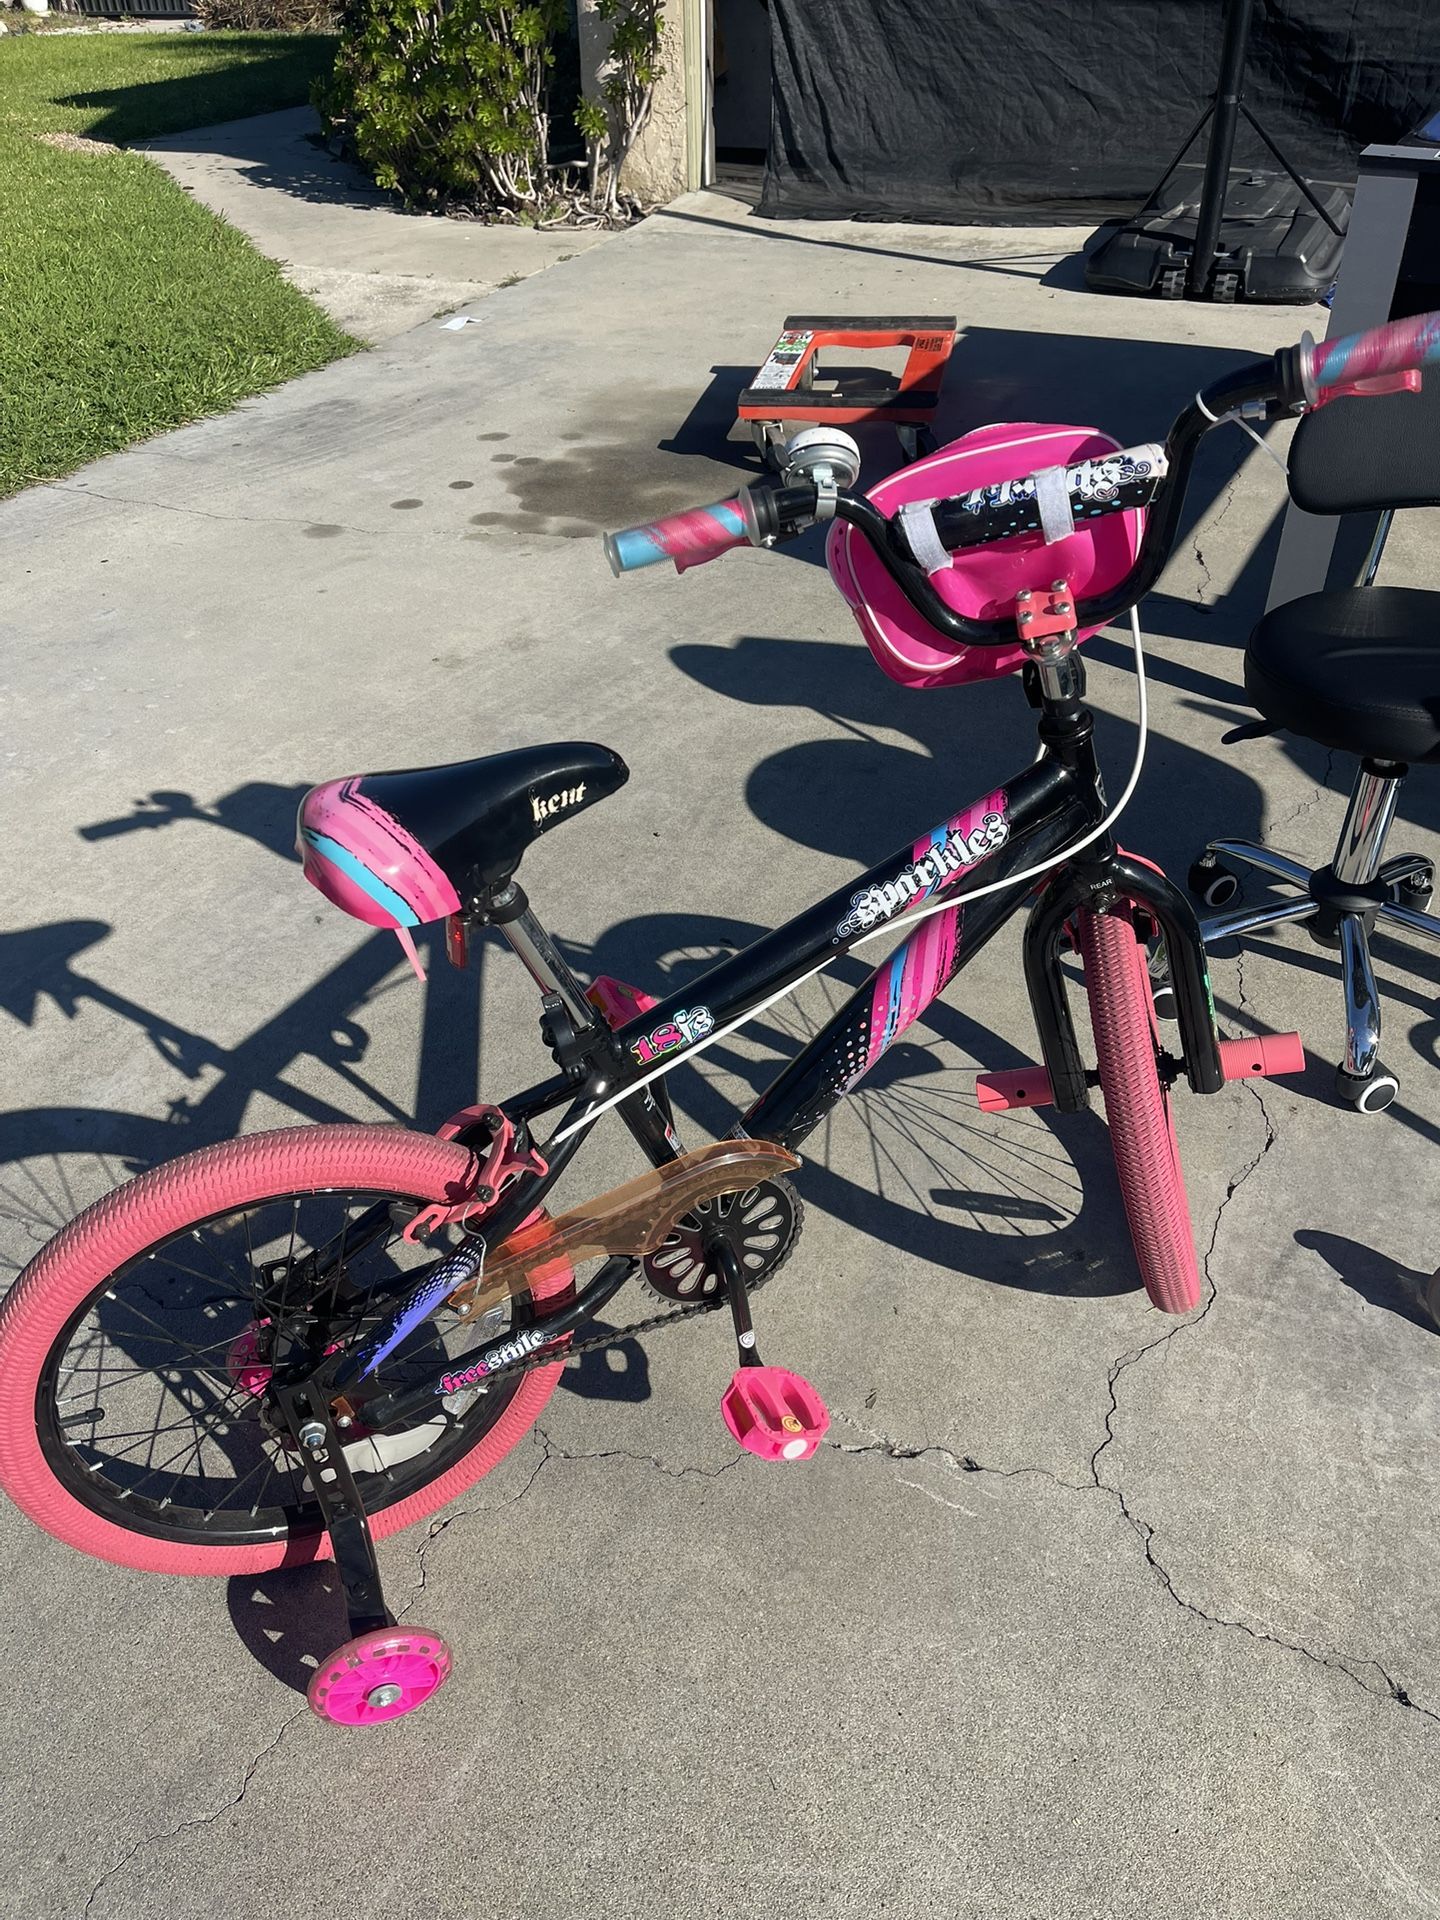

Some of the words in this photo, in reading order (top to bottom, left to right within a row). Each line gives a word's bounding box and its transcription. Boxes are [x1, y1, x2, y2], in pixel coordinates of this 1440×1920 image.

[530, 781, 587, 826] kent
[837, 812, 1010, 937] Sparkles
[1089, 877, 1113, 890] REAR
